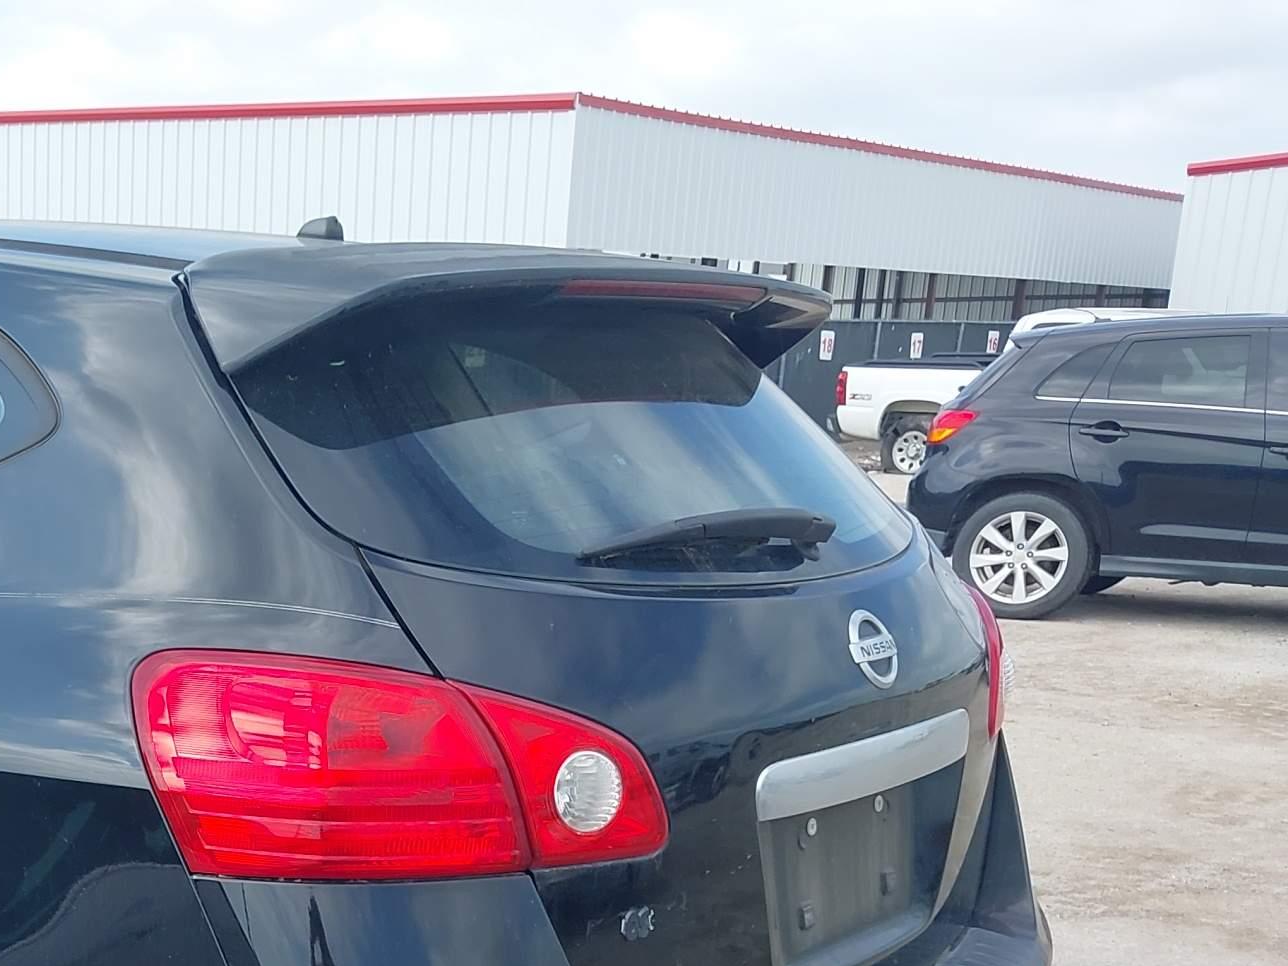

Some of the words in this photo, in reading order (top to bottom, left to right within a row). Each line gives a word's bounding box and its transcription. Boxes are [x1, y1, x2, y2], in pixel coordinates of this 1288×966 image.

[822, 336, 833, 353] 18
[912, 338, 922, 351] 17
[989, 337, 999, 351] 16
[860, 639, 896, 658] NISSAN
